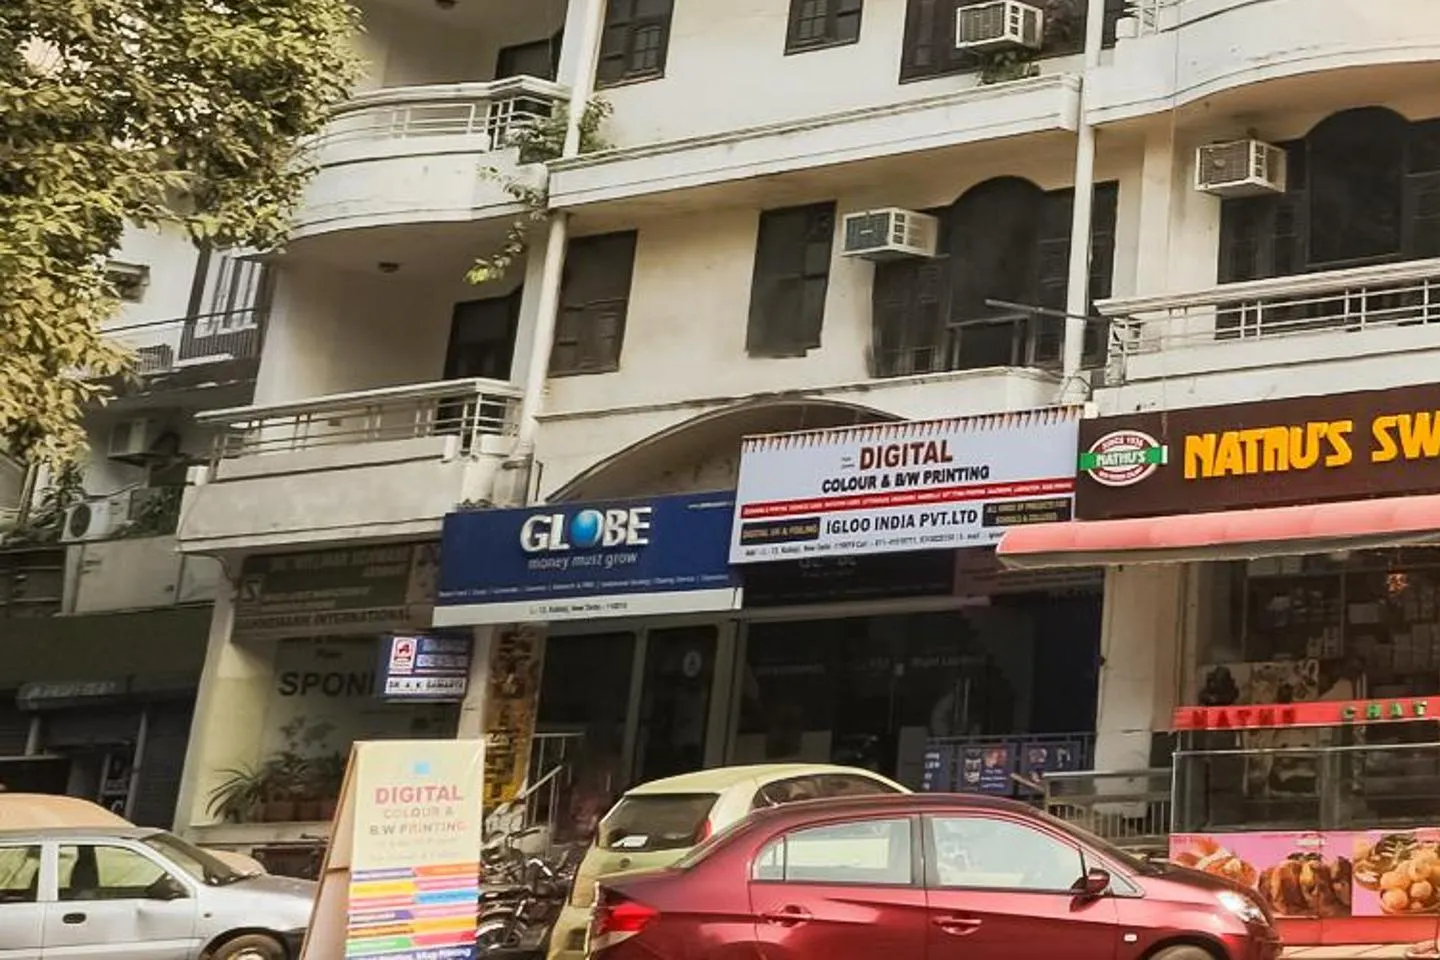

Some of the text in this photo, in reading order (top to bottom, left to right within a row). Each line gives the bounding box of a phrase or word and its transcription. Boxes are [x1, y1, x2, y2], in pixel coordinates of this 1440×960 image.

[859, 439, 954, 471] DIGITAL
[1095, 449, 1147, 467] NATHU'S
[1184, 419, 1354, 480] NATHU'S
[822, 474, 878, 494] COLOUR
[881, 473, 891, 489] &
[922, 465, 990, 485] PRINTING
[520, 506, 652, 552] GLOBE
[826, 518, 871, 535] IGLOO
[874, 514, 916, 530] INDIA
[919, 510, 979, 528] PVT.LTD
[527, 552, 638, 571] money must grow
[374, 783, 465, 805] DIGITAL
[383, 806, 440, 820] COLOUR
